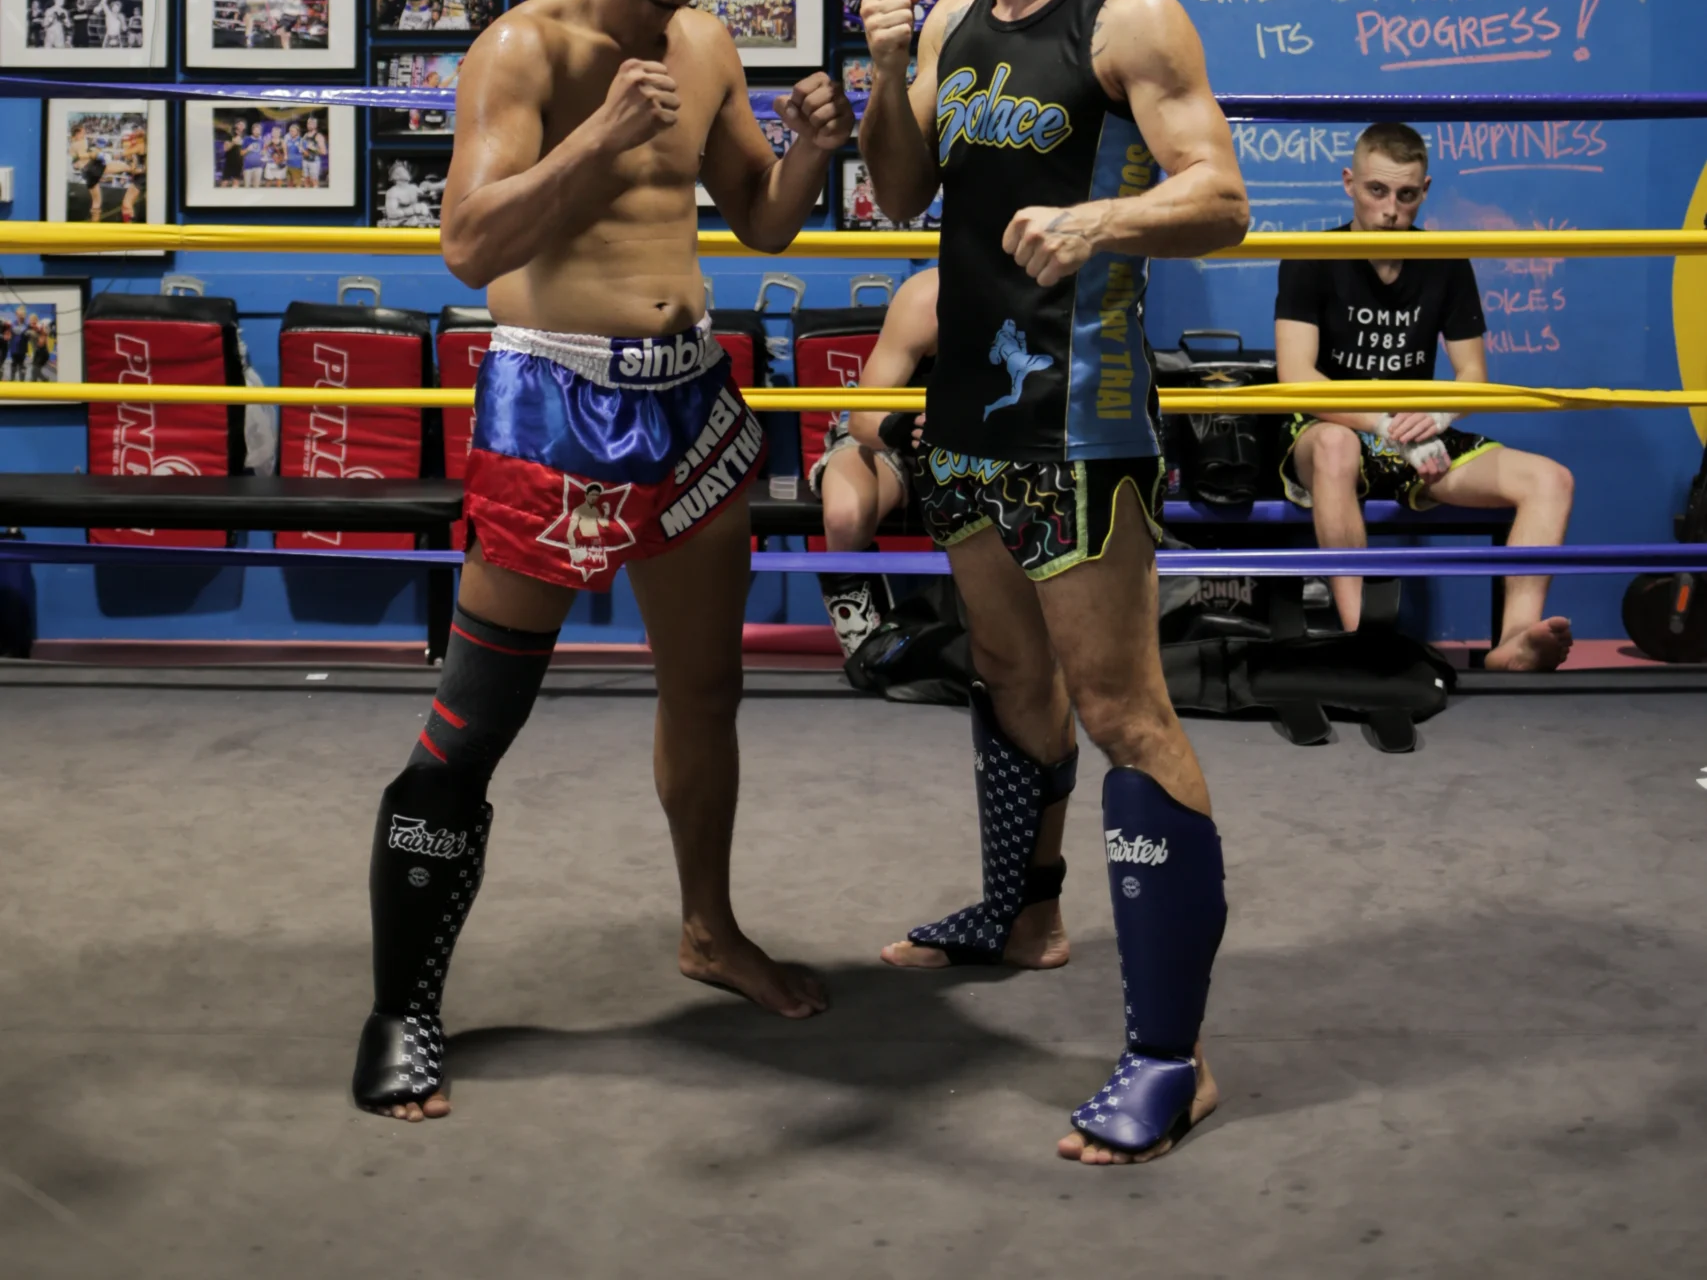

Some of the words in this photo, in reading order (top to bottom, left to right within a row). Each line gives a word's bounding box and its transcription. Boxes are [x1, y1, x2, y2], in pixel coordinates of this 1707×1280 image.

[1256, 22, 1314, 59] ITS
[937, 62, 1072, 167] Solace
[1233, 123, 1365, 163] ROGRE
[1437, 120, 1607, 161] HAPPYNESS
[1099, 261, 1135, 343] MUAY
[1347, 306, 1421, 327] TOMMY
[1483, 286, 1567, 315] OKES
[1357, 331, 1406, 349] 1985
[1485, 324, 1560, 354] KILLS
[1332, 349, 1426, 372] HILFIGER
[1096, 350, 1134, 420] THAI
[674, 387, 742, 485] SINBI
[389, 814, 467, 859] Fairtex
[1105, 828, 1168, 866] Fairtex
